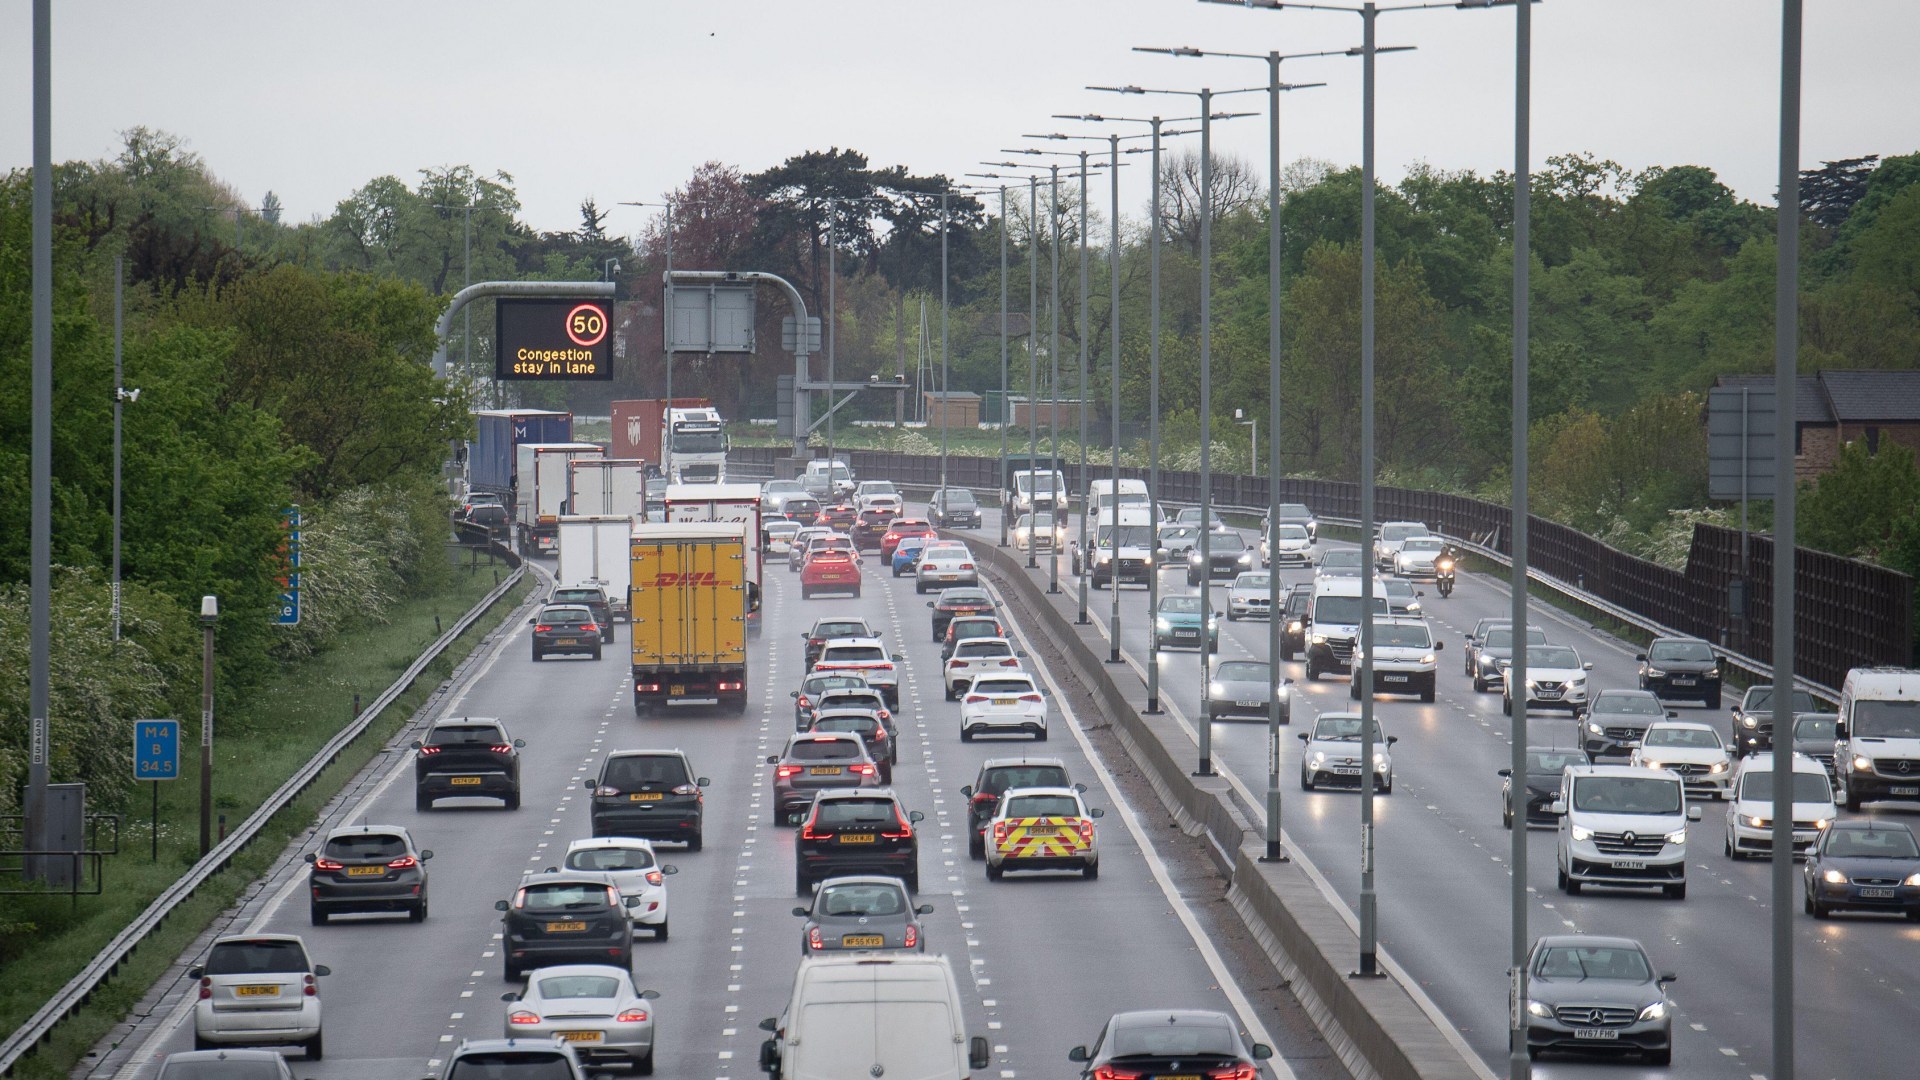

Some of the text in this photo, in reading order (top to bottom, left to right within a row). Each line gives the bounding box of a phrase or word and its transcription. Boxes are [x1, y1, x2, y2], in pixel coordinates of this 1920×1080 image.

[574, 316, 601, 334] 50
[517, 348, 592, 361] Congestion
[514, 362, 595, 375] stay in lane
[515, 427, 526, 438] M
[655, 573, 720, 586] DHL
[145, 727, 169, 738] M4
[34, 719, 42, 763] 2345B
[152, 744, 161, 755] B
[141, 760, 173, 772] 34.5
[866, 936, 879, 945] KVS
[1577, 1029, 1615, 1038] HV67 FHG
